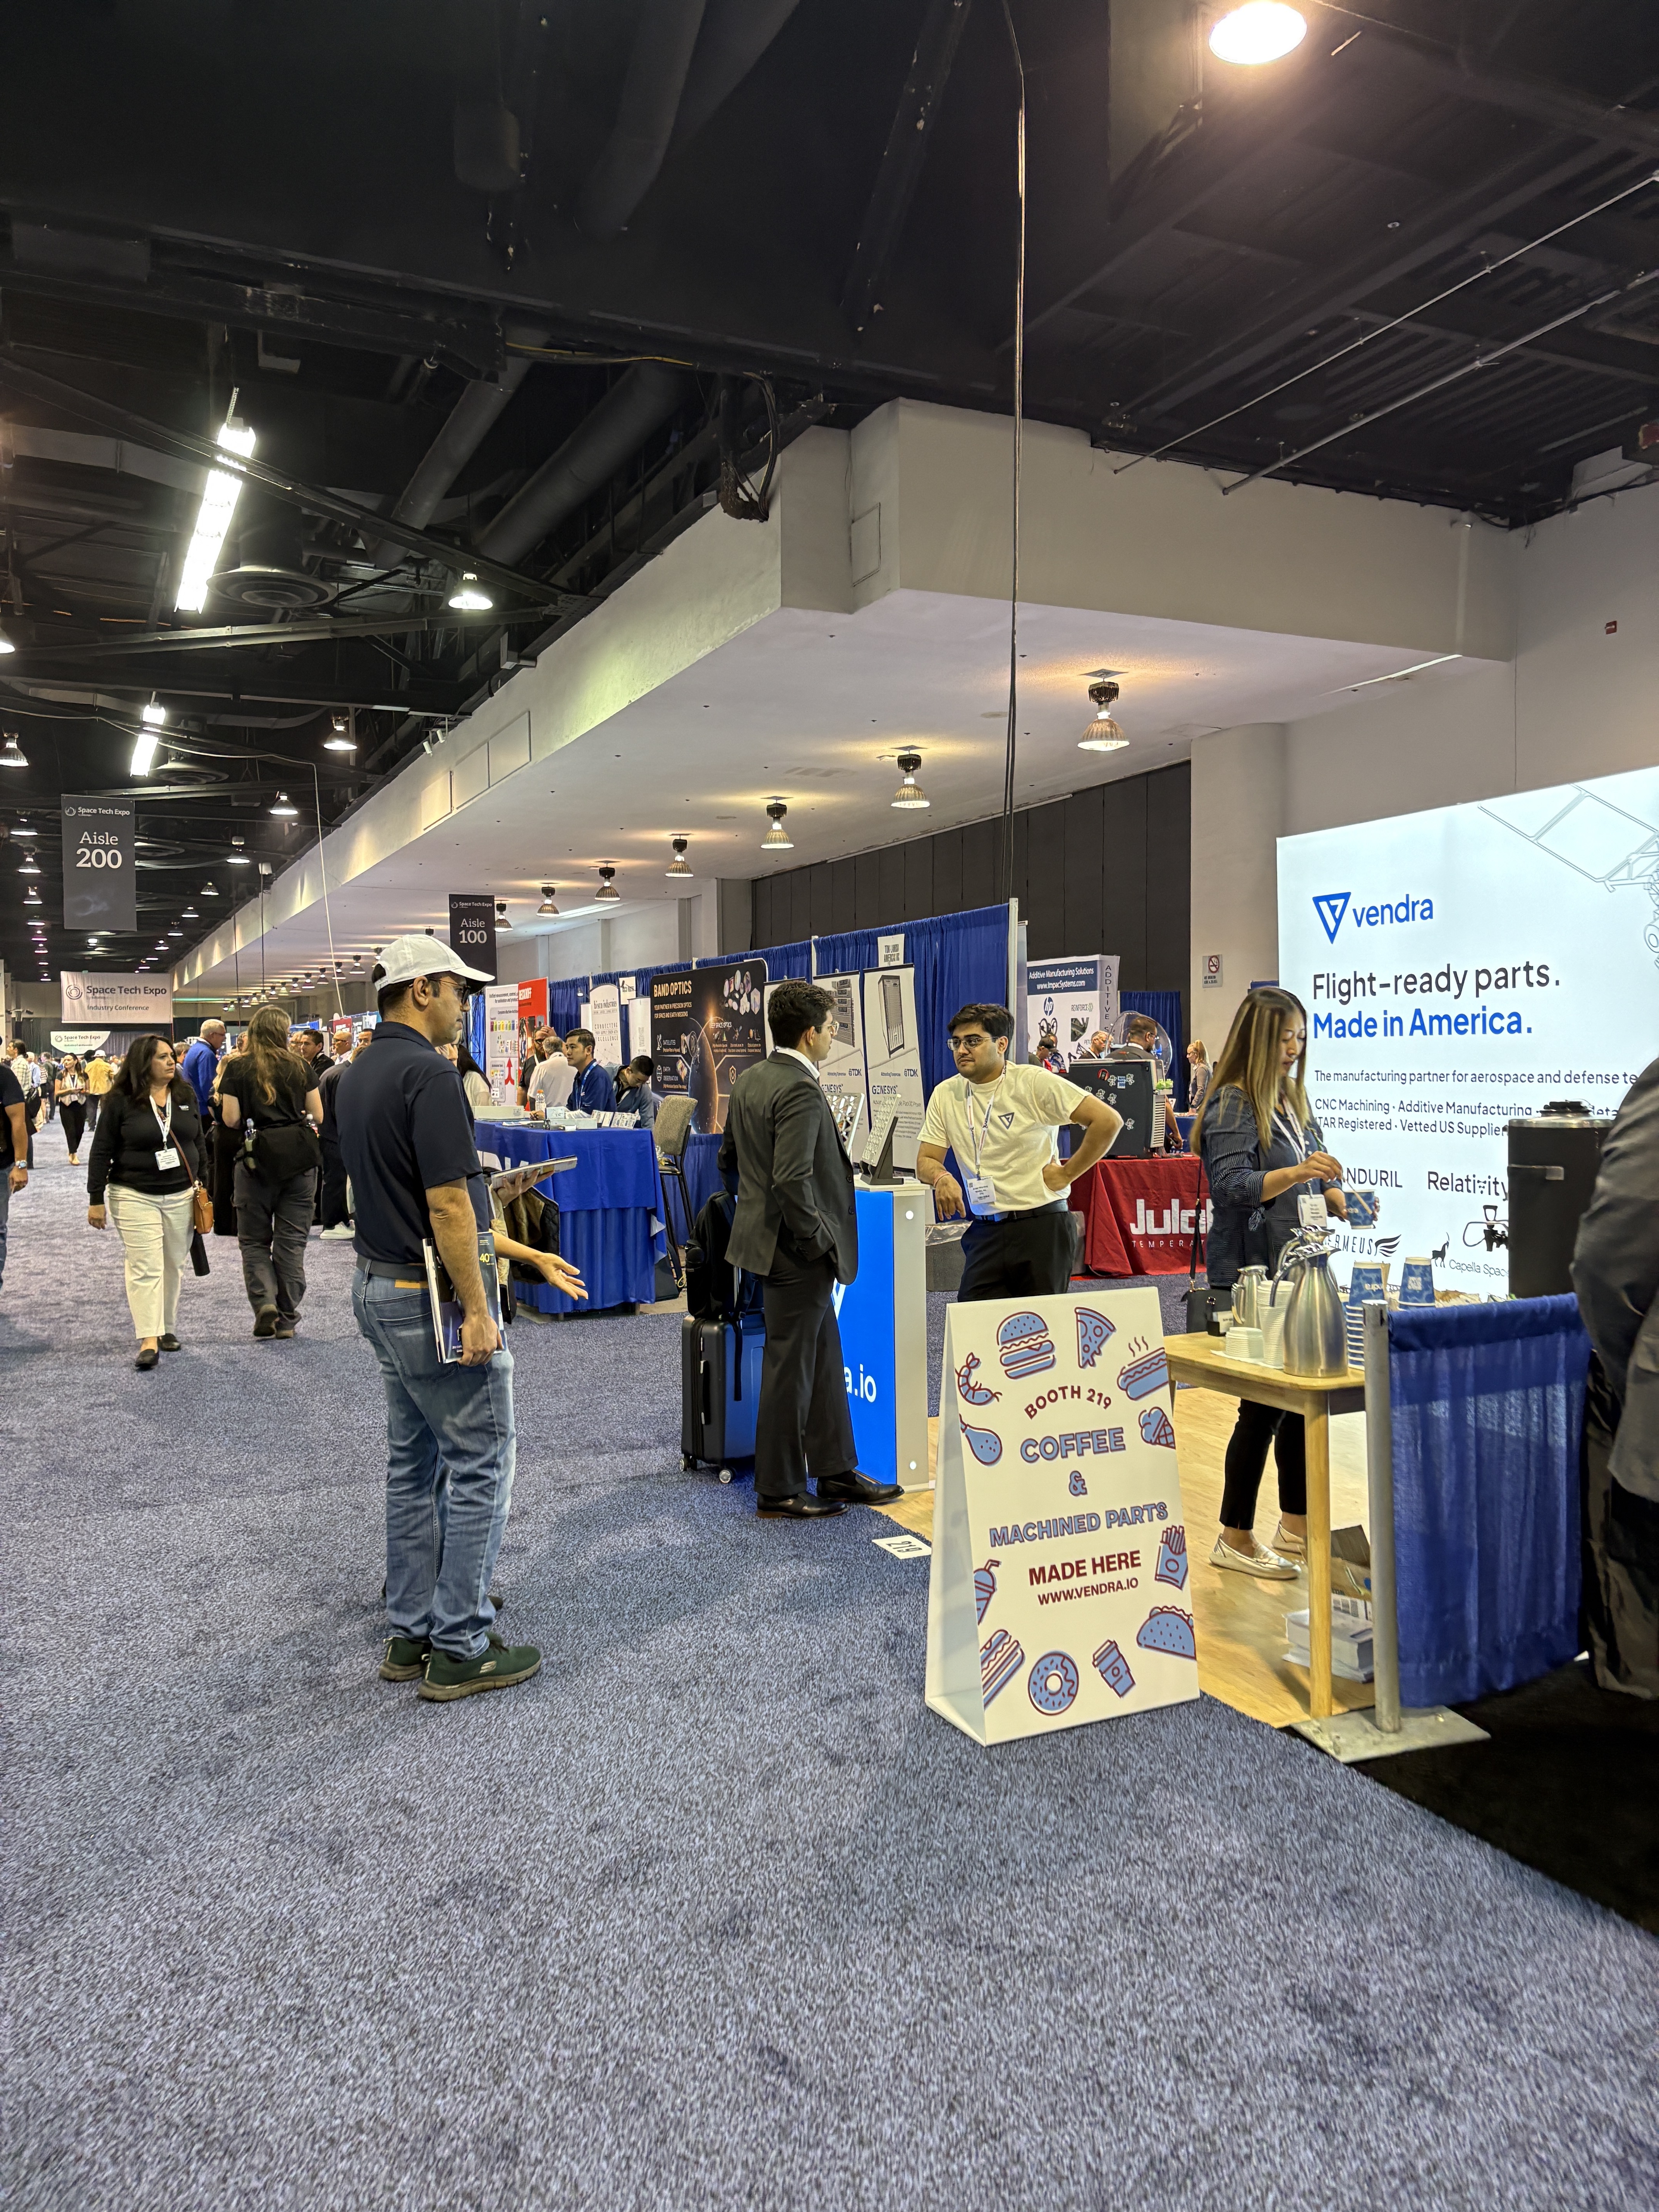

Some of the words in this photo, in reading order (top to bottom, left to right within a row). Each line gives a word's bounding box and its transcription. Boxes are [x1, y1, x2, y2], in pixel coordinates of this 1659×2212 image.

[79, 831, 118, 845] Aisle
[76, 848, 122, 869] 200
[1352, 893, 1433, 928] vendra
[460, 918, 485, 927] Aisle
[459, 930, 487, 944] 100
[1029, 970, 1046, 979] Additive
[1046, 968, 1075, 977] Manufacturing
[1075, 967, 1094, 975] Solutions
[86, 986, 115, 996] Space
[118, 986, 141, 994] Tech
[144, 986, 167, 996] Expo
[654, 983, 669, 997] BAND
[670, 980, 692, 996] OPTICS
[1314, 963, 1468, 1005] Flight-ready
[1475, 961, 1559, 998] parts.
[1044, 997, 1053, 1016] hp
[1314, 1010, 1377, 1039] Made
[1383, 1010, 1403, 1037] in
[1409, 1005, 1532, 1036] America.
[1314, 1070, 1331, 1081] The
[1333, 1070, 1407, 1085] manufacturing
[1410, 1071, 1450, 1085] partner
[1452, 1070, 1468, 1082] for
[1471, 1072, 1534, 1085] aerospace
[1537, 1070, 1561, 1084] and
[1564, 1070, 1620, 1084] defense
[1315, 1098, 1337, 1110] CNC
[1339, 1099, 1390, 1115] Machining
[1398, 1100, 1444, 1113] Additive
[1316, 1116, 1336, 1128] TAR
[1338, 1117, 1392, 1132] Registered
[1400, 1118, 1437, 1132] Vetted
[1439, 1120, 1455, 1134] US
[1346, 1167, 1403, 1188] NDURIL
[479, 1253, 490, 1262] 40
[1449, 1259, 1481, 1274] Capella
[1024, 1385, 1081, 1420] BOOTH
[1086, 1388, 1111, 1410] 219
[1020, 1427, 1126, 1463] COFFEE
[1068, 1470, 1088, 1496] &
[989, 1513, 1101, 1547] MACHINED
[1105, 1501, 1168, 1529] PARTS
[886, 1541, 922, 1553] 219
[1029, 1559, 1087, 1586] MADE
[1091, 1550, 1142, 1575] HERE
[1038, 1577, 1139, 1605] WWW.VENDRA.IO
